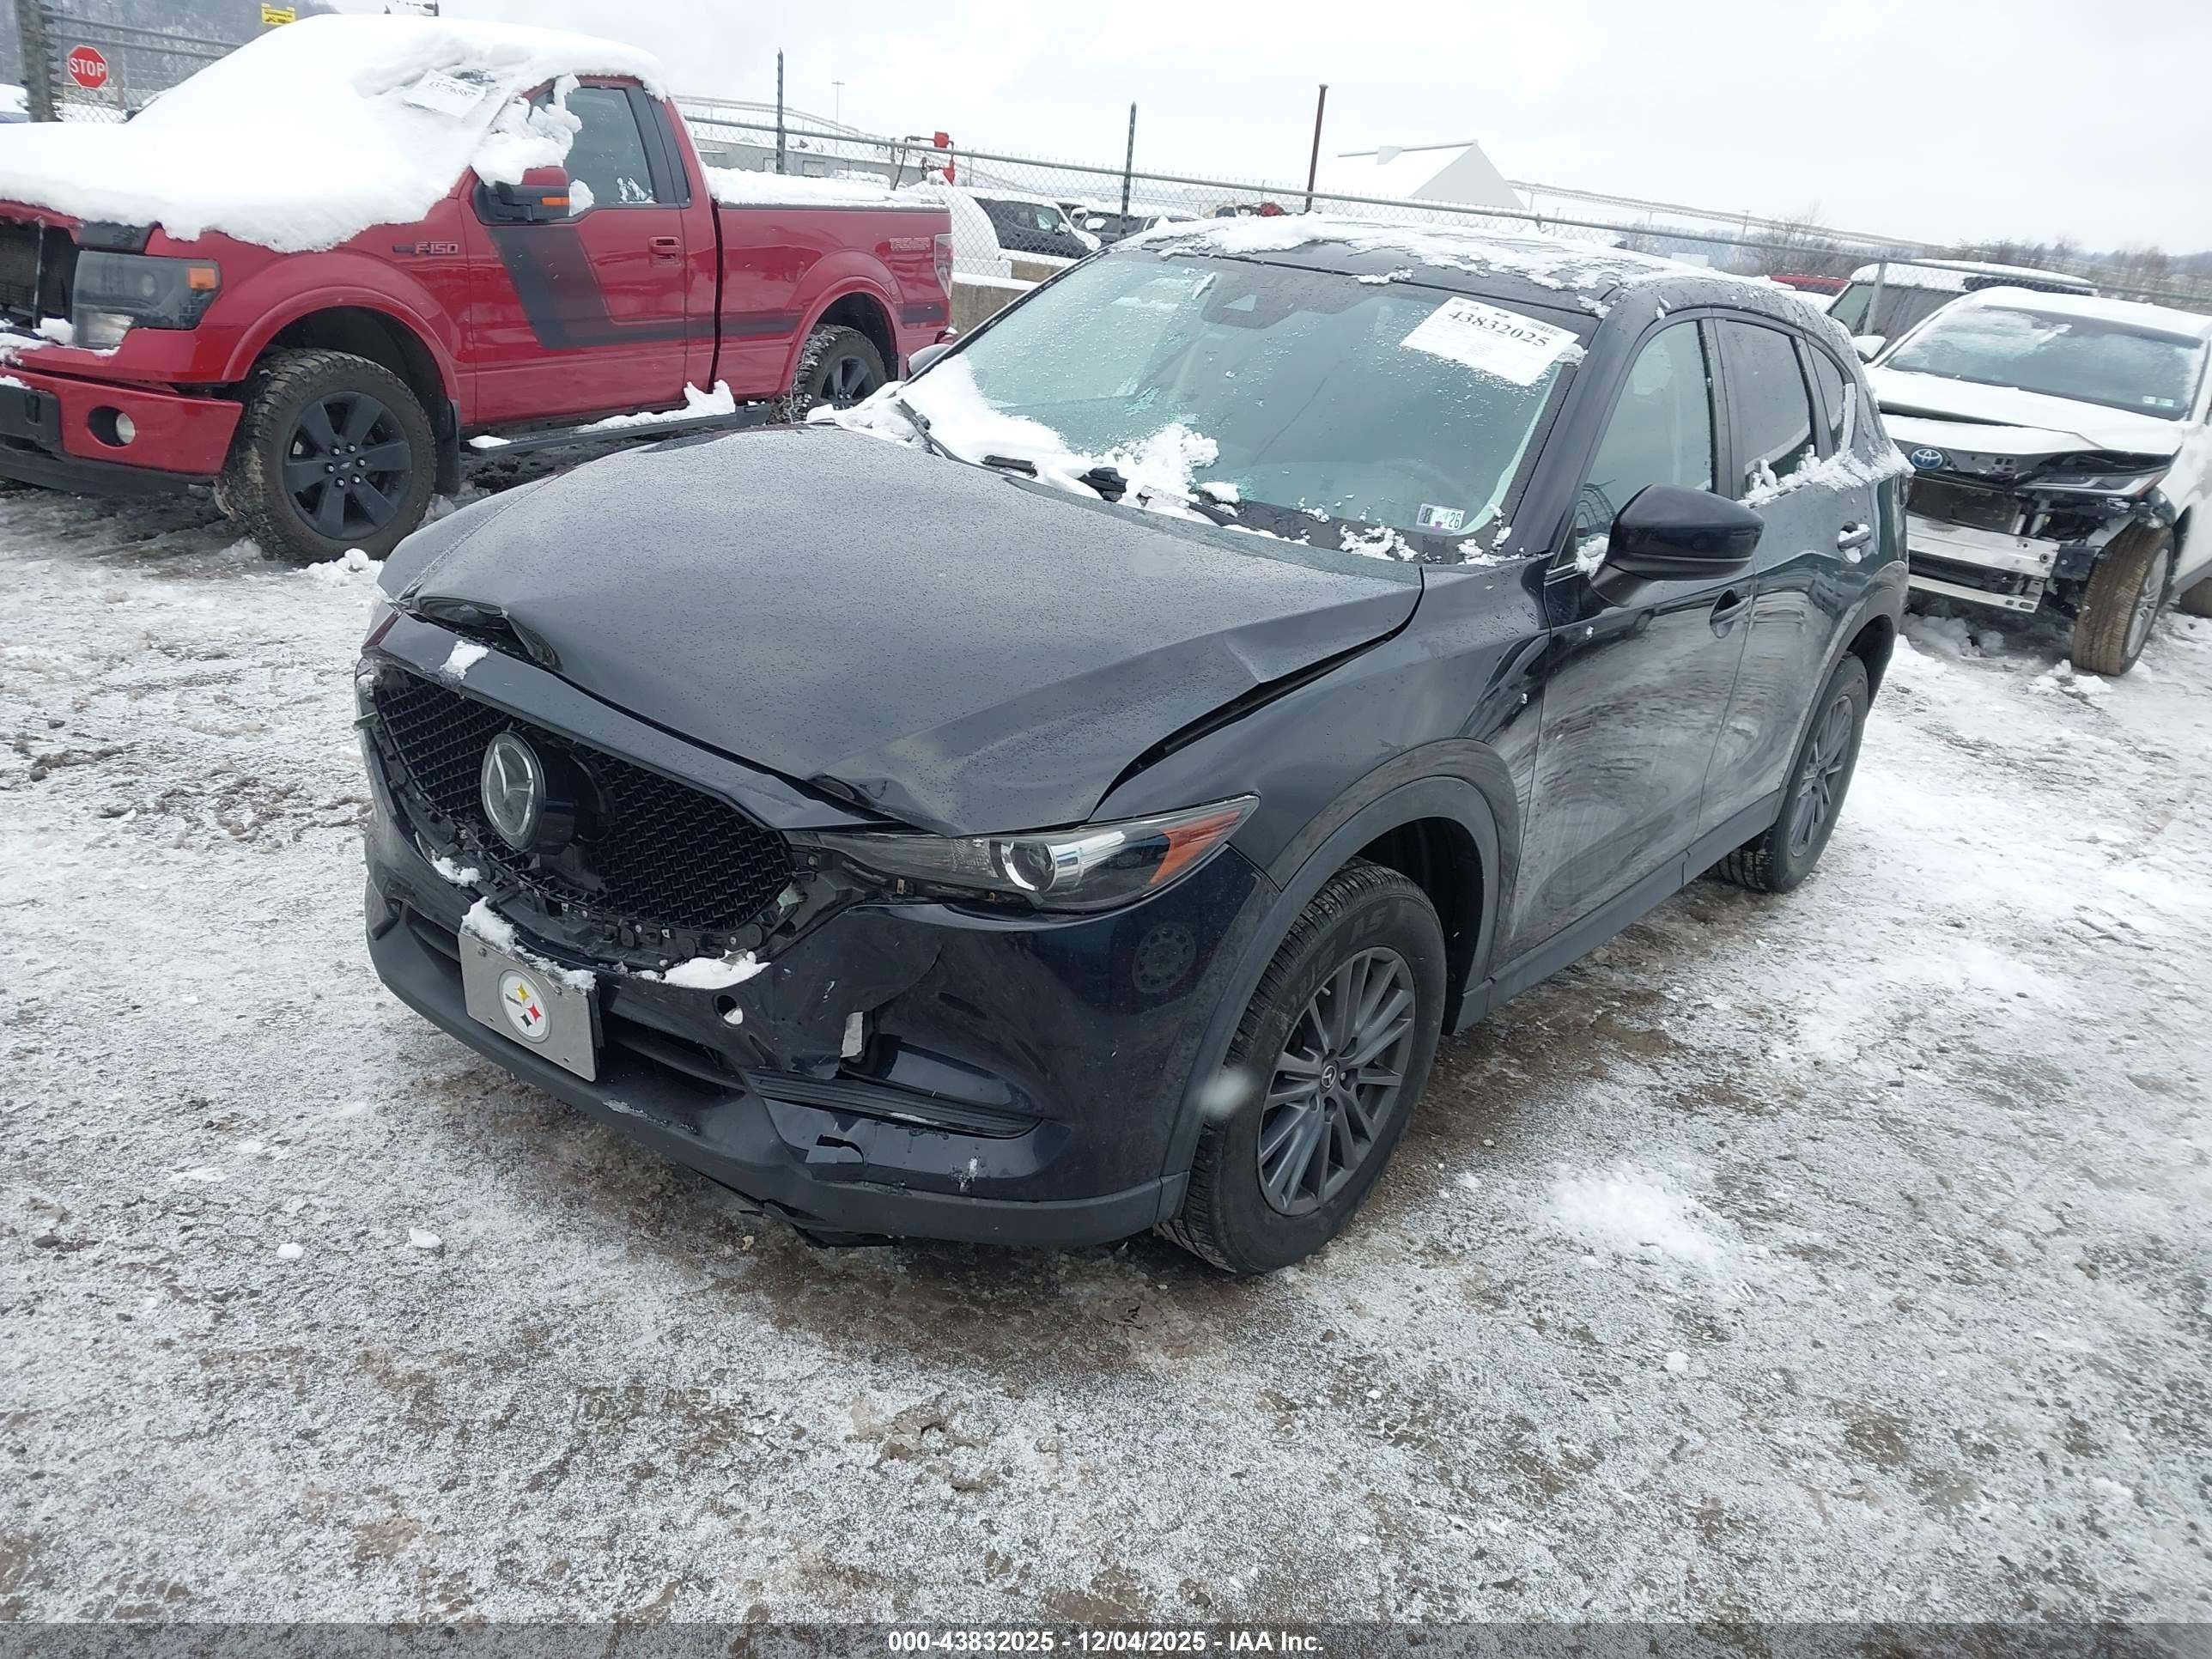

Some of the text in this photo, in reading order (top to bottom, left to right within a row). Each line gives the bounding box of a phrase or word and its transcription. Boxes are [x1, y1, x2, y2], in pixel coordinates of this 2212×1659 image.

[70, 58, 105, 77] STOP
[415, 241, 459, 255] F-150
[1448, 311, 1551, 348] 43832025
[1448, 512, 1462, 528] 26
